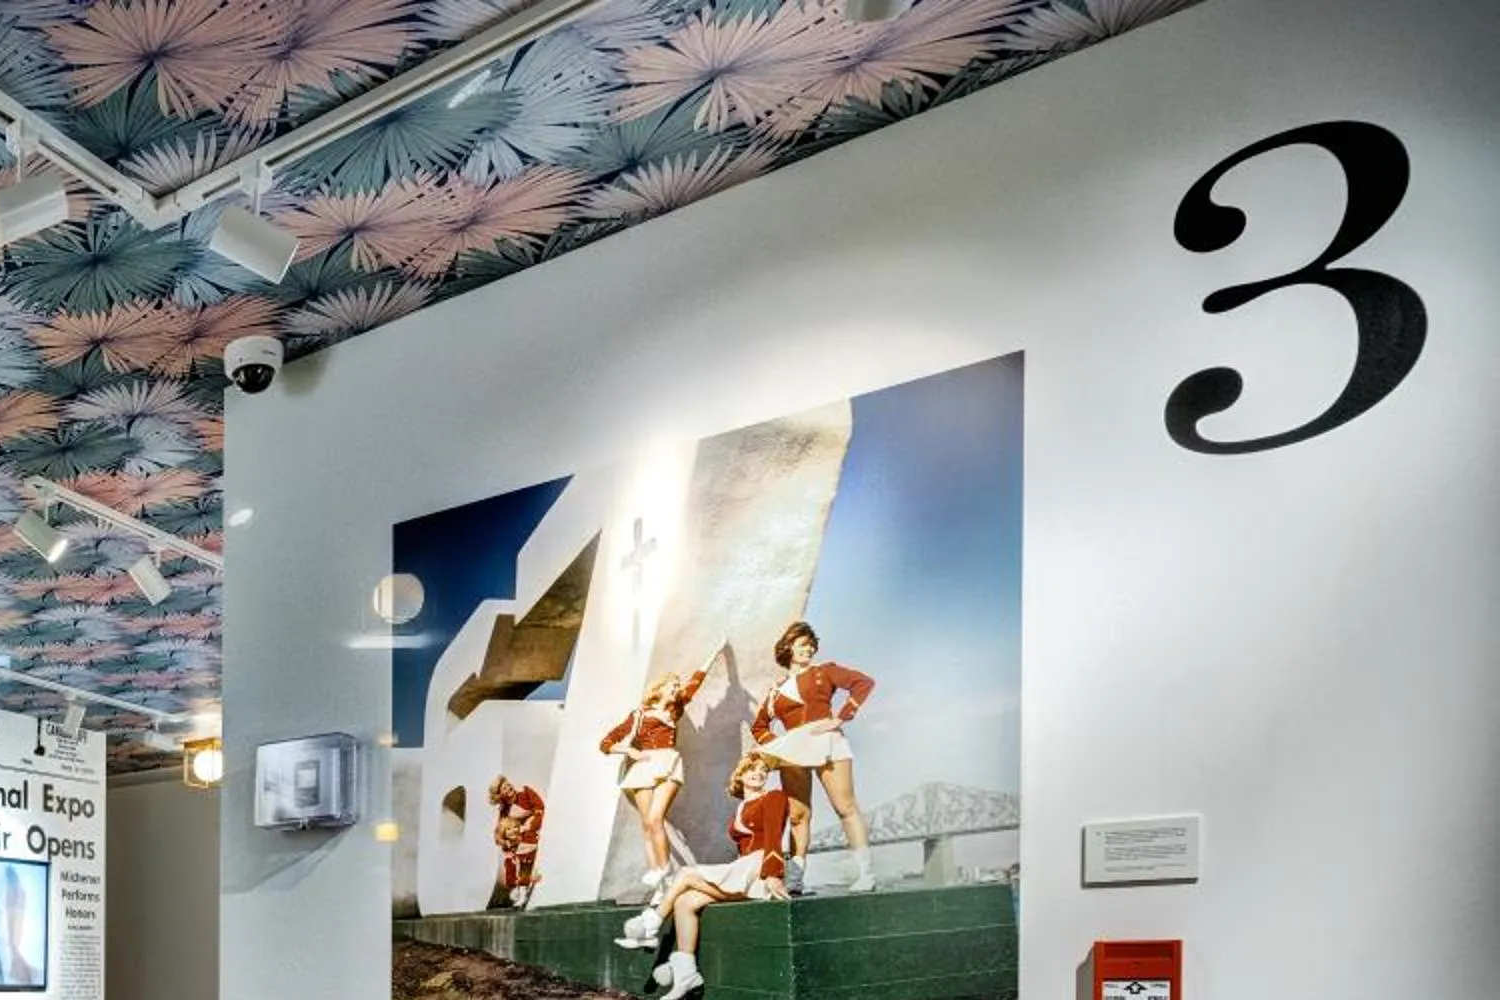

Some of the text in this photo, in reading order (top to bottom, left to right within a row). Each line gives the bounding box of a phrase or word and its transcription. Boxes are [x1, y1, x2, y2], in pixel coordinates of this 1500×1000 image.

[1164, 120, 1429, 455] 3
[42, 783, 95, 822] Expo
[26, 824, 95, 862] Opens
